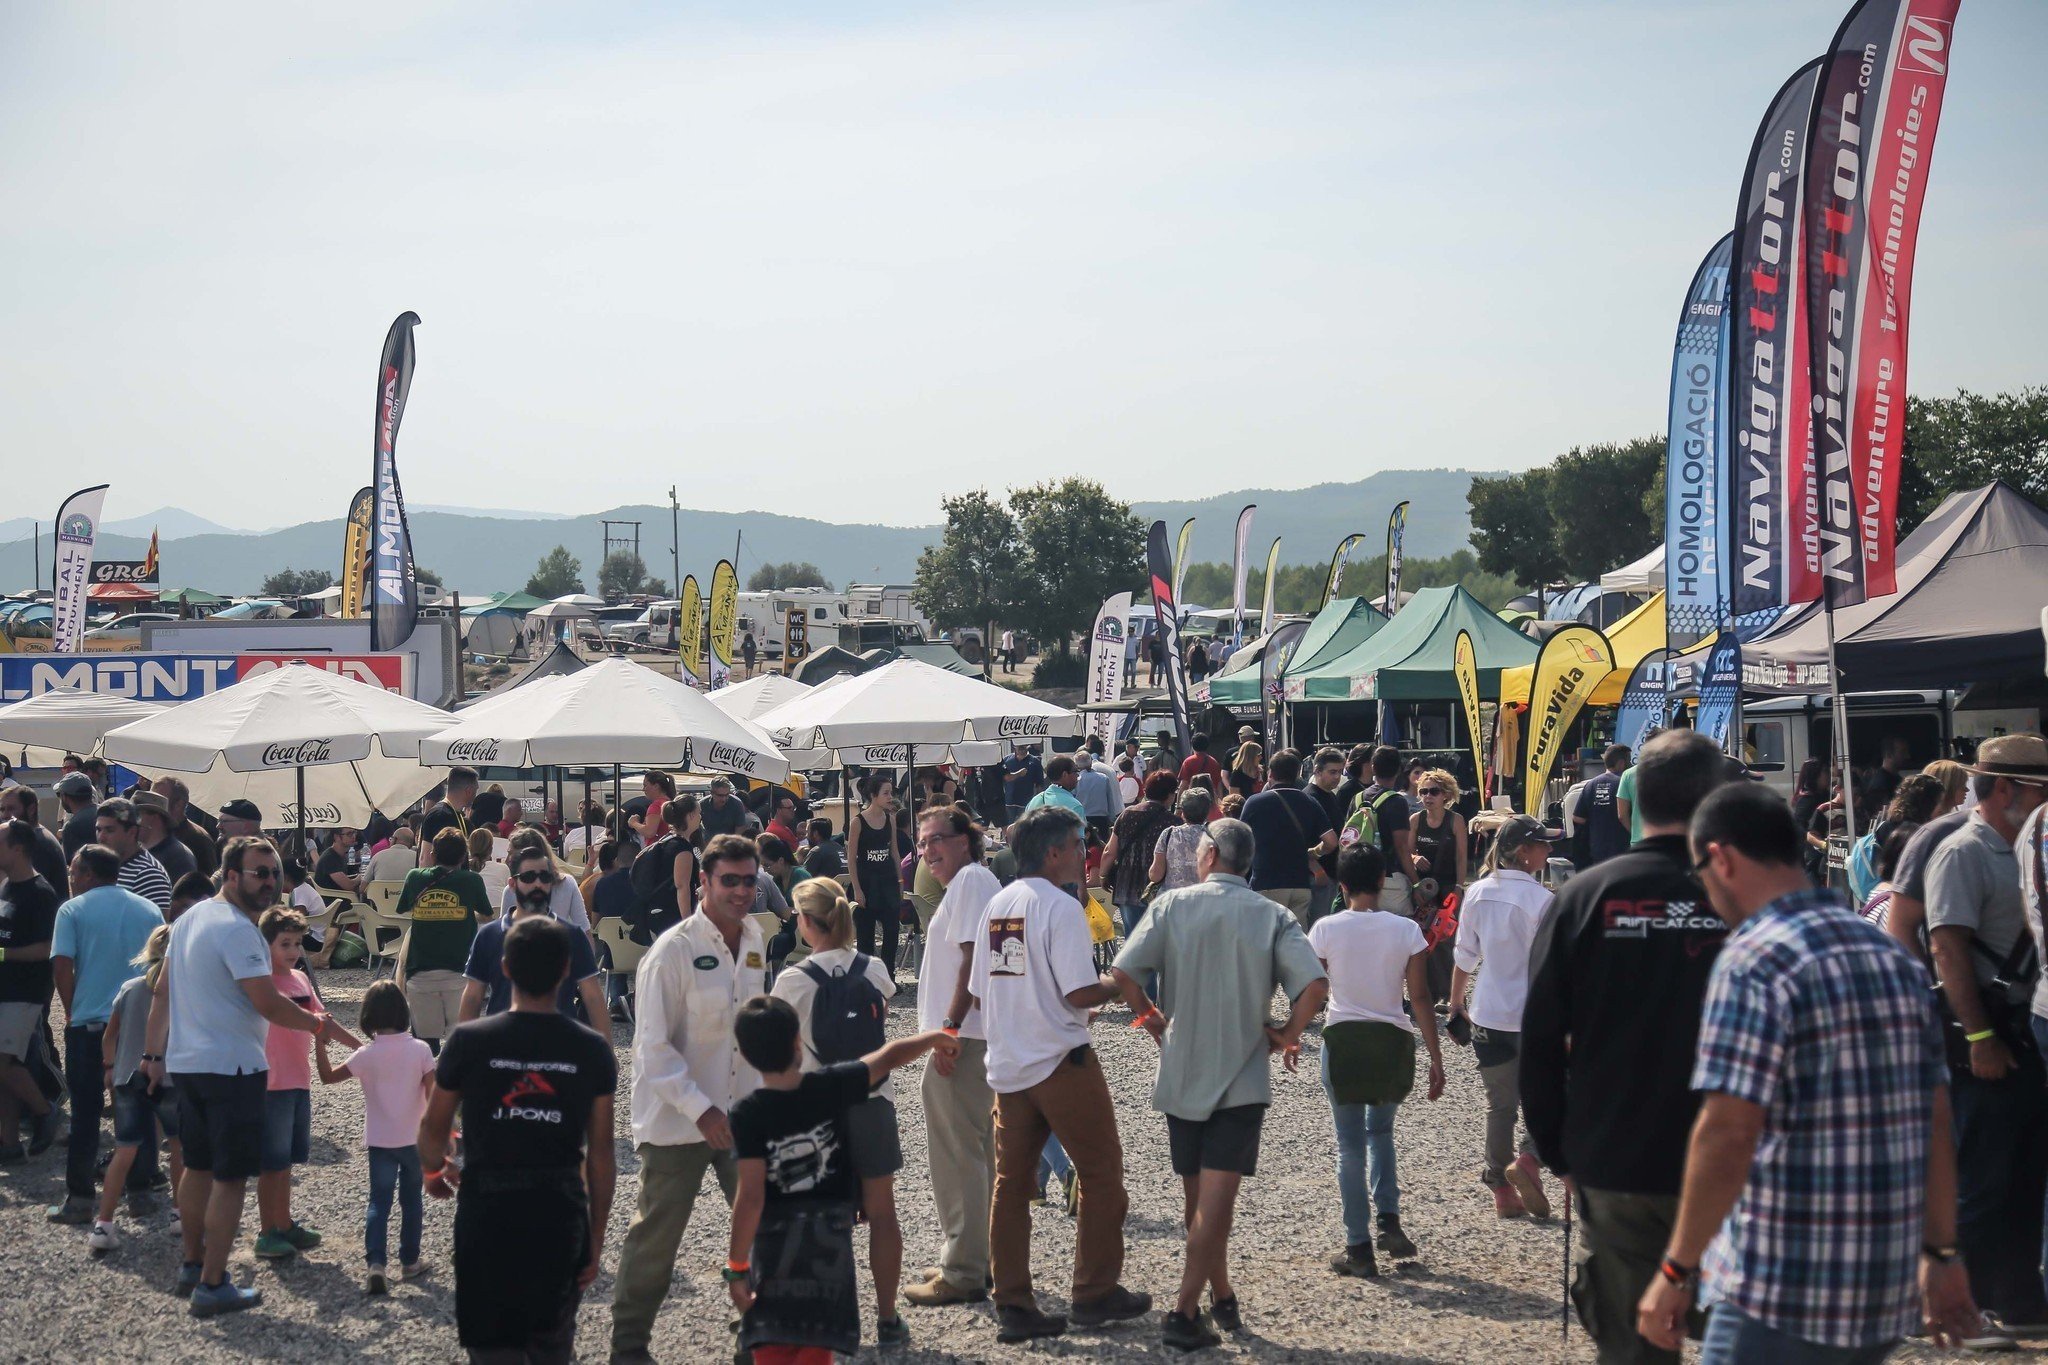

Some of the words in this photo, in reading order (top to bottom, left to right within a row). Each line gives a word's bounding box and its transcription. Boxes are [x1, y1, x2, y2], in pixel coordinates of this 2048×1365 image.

[1861, 357, 1894, 562] adventure
[1880, 83, 1928, 333] technologies
[1739, 170, 1785, 590] Navigattor
[1677, 363, 1711, 598] HOMOLOGACIÓ
[790, 614, 804, 623] WC
[998, 715, 1050, 737] Coca-Cola
[262, 738, 334, 766] Coca-Cola
[447, 737, 502, 762] Coca-Cola
[709, 741, 757, 773] Coca-Cola
[421, 892, 457, 904] CAMEL
[509, 1107, 562, 1123] PONS
